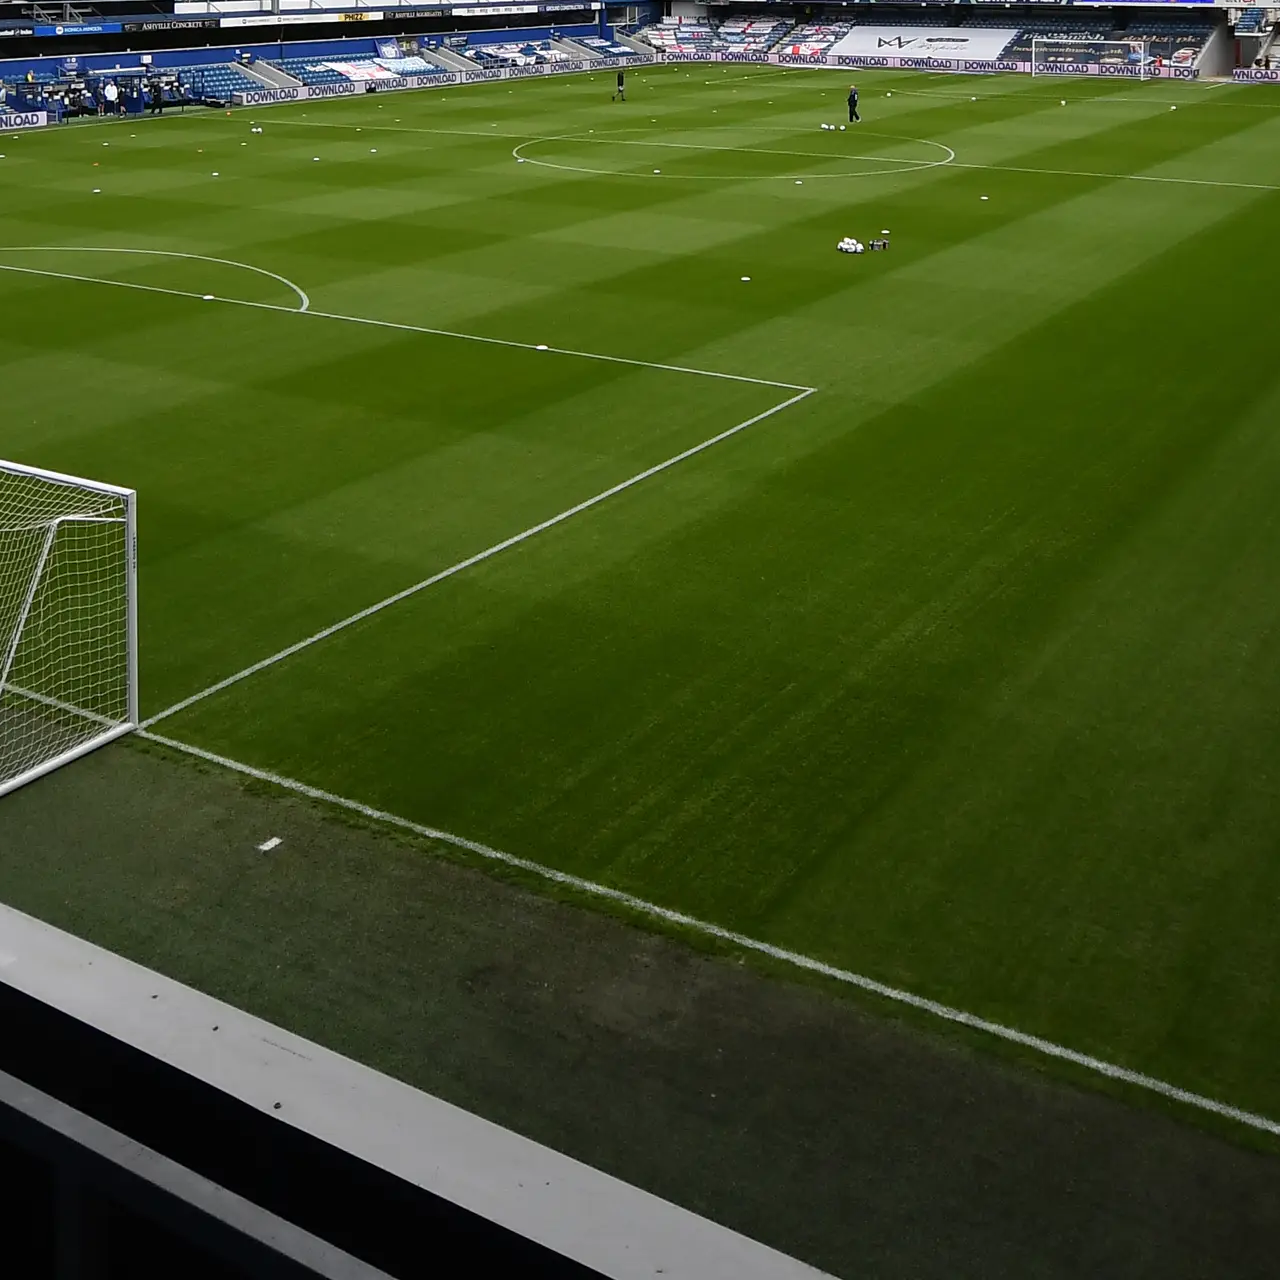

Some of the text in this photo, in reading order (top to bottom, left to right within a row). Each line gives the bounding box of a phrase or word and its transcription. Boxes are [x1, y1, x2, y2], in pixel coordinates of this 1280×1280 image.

[344, 13, 364, 21] PHIZZ
[142, 20, 203, 31] ASHVILLE CONCRETE
[625, 55, 654, 64] DOWNLOAD
[661, 51, 712, 62] DOWNLOAD
[721, 53, 769, 63] DOWNLOAD
[778, 55, 828, 64] DOWNLOAD
[838, 57, 889, 66] DOWNLOAD
[550, 62, 584, 72] DOWNLOAD
[589, 58, 620, 68] DOWNLOAD
[900, 58, 952, 68] DOWNLOAD
[964, 60, 1018, 70] DOWNLOAD
[465, 70, 502, 81] DOWNLOAD
[509, 66, 544, 77] DOWNLOAD
[1101, 65, 1161, 76] DOWNLOAD
[364, 79, 408, 91] DOWNLOAD
[416, 75, 457, 86] DOWNLOAD
[308, 83, 356, 97] DOWNLOAD
[246, 88, 299, 103] DOWNLOAD
